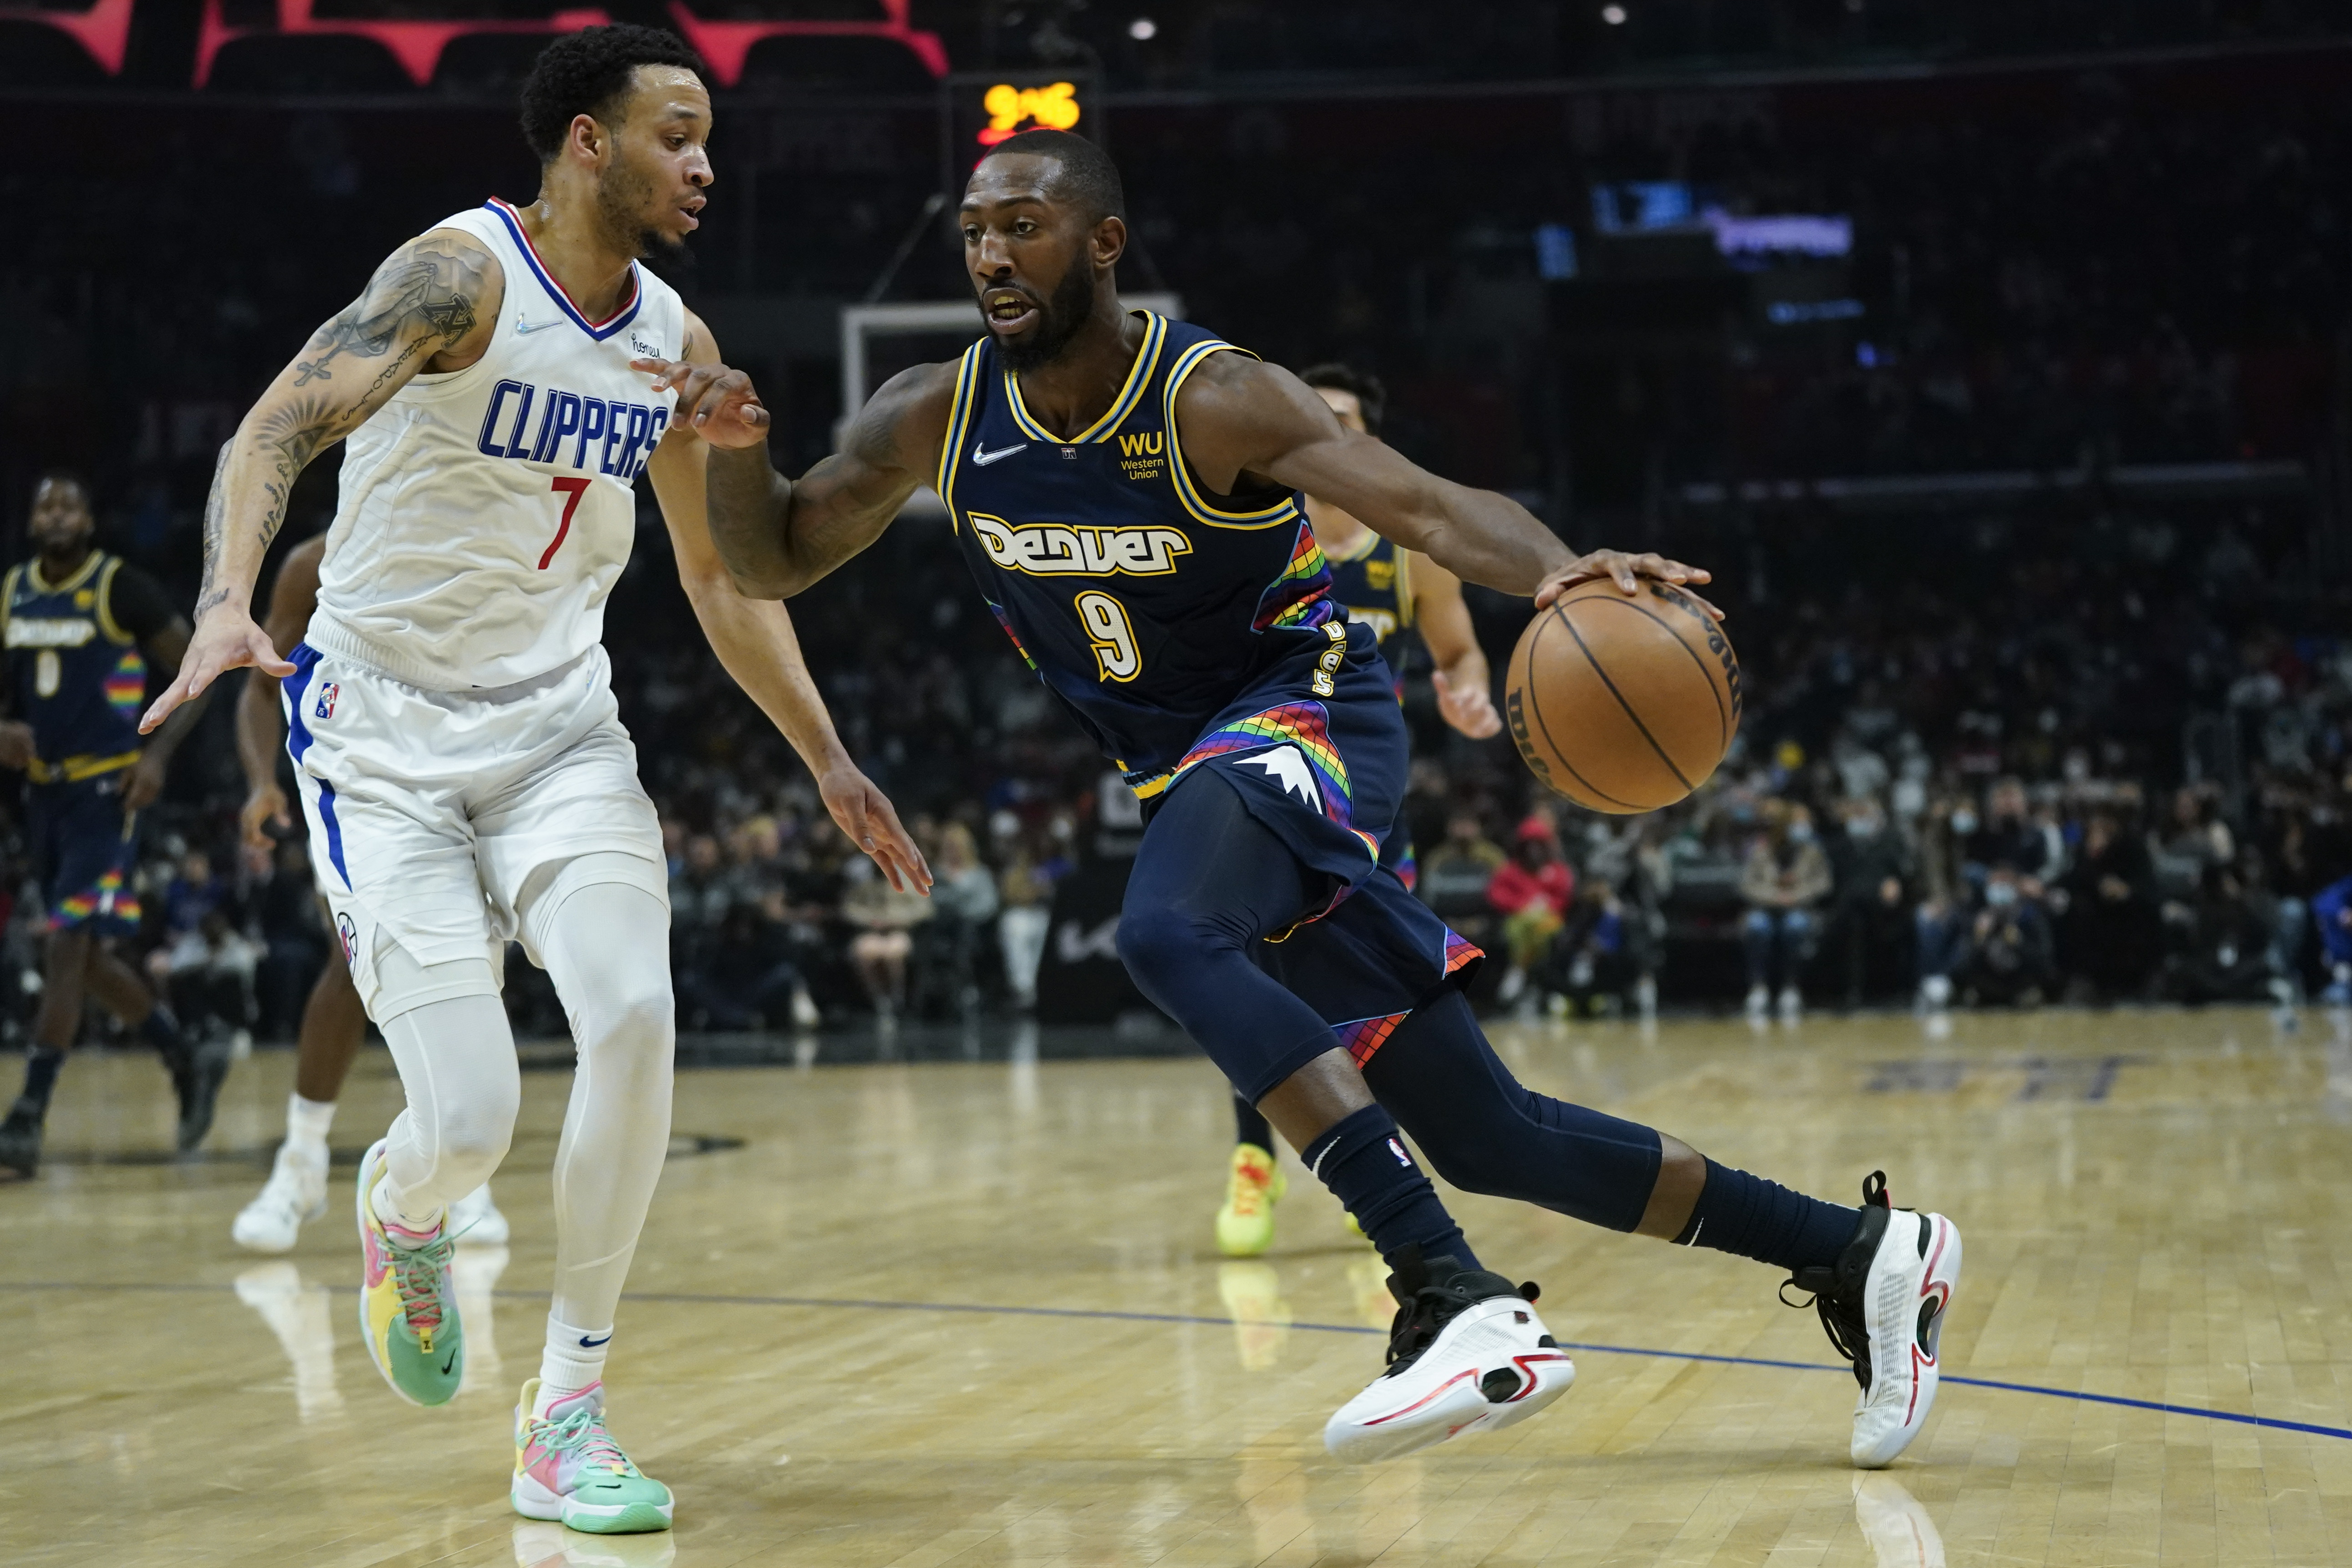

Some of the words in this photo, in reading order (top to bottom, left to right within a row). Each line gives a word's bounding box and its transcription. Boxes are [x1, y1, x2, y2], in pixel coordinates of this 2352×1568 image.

[631, 333, 660, 359] honey
[478, 379, 668, 481] CLIPPERS
[1118, 431, 1162, 457] WU
[1121, 459, 1164, 470] Western
[1130, 469, 1158, 480] Union
[538, 477, 592, 570] 7
[1075, 590, 1142, 682] 9
